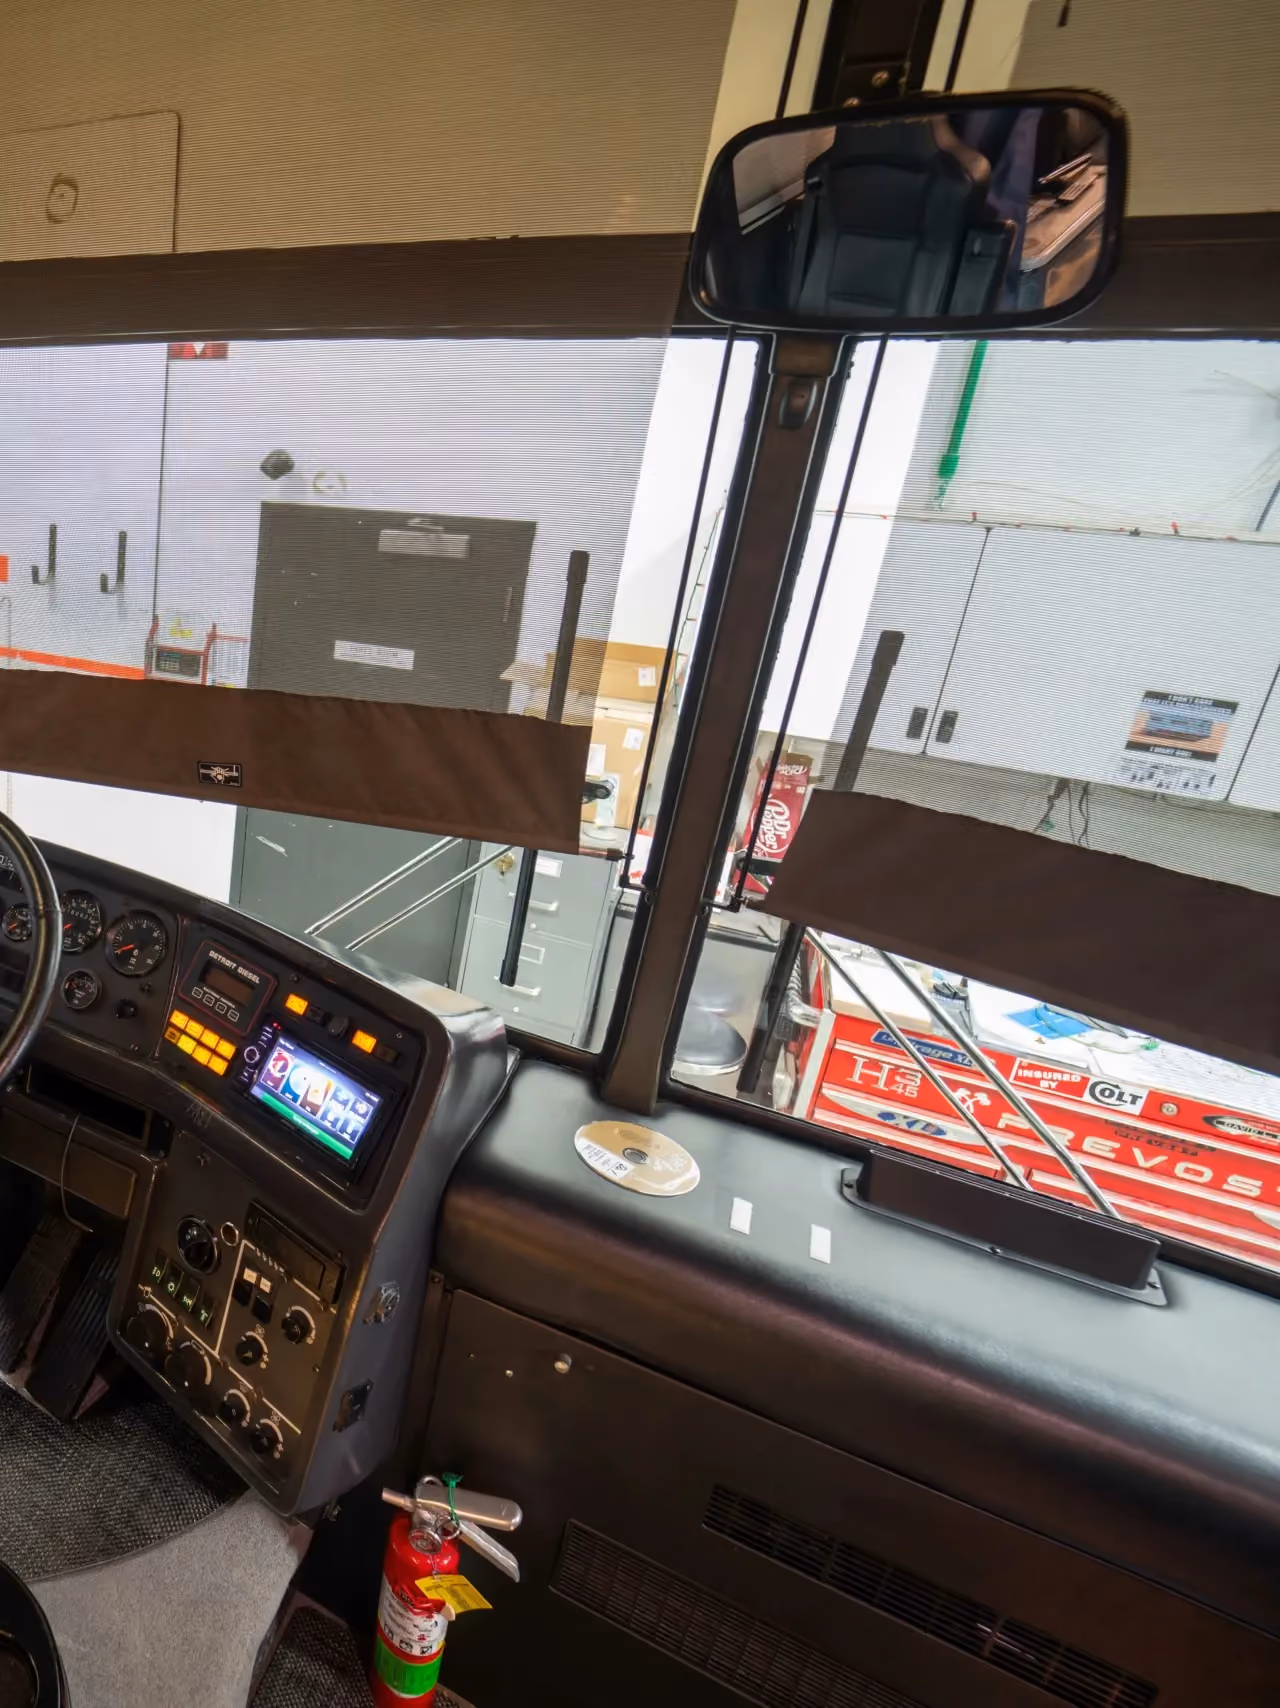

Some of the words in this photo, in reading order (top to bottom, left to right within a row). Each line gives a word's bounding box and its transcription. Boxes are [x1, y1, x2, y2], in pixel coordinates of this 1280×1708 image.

[773, 820, 791, 840] Dr
[208, 950, 238, 970] DETROIT
[237, 965, 260, 984] DIESEL
[846, 1055, 922, 1091] H3
[1017, 1068, 1082, 1083] INSURED
[1039, 1079, 1058, 1090] BY
[888, 1082, 919, 1099] 45
[1088, 1080, 1143, 1107] COLT
[997, 1112, 1280, 1198] PREVOS
